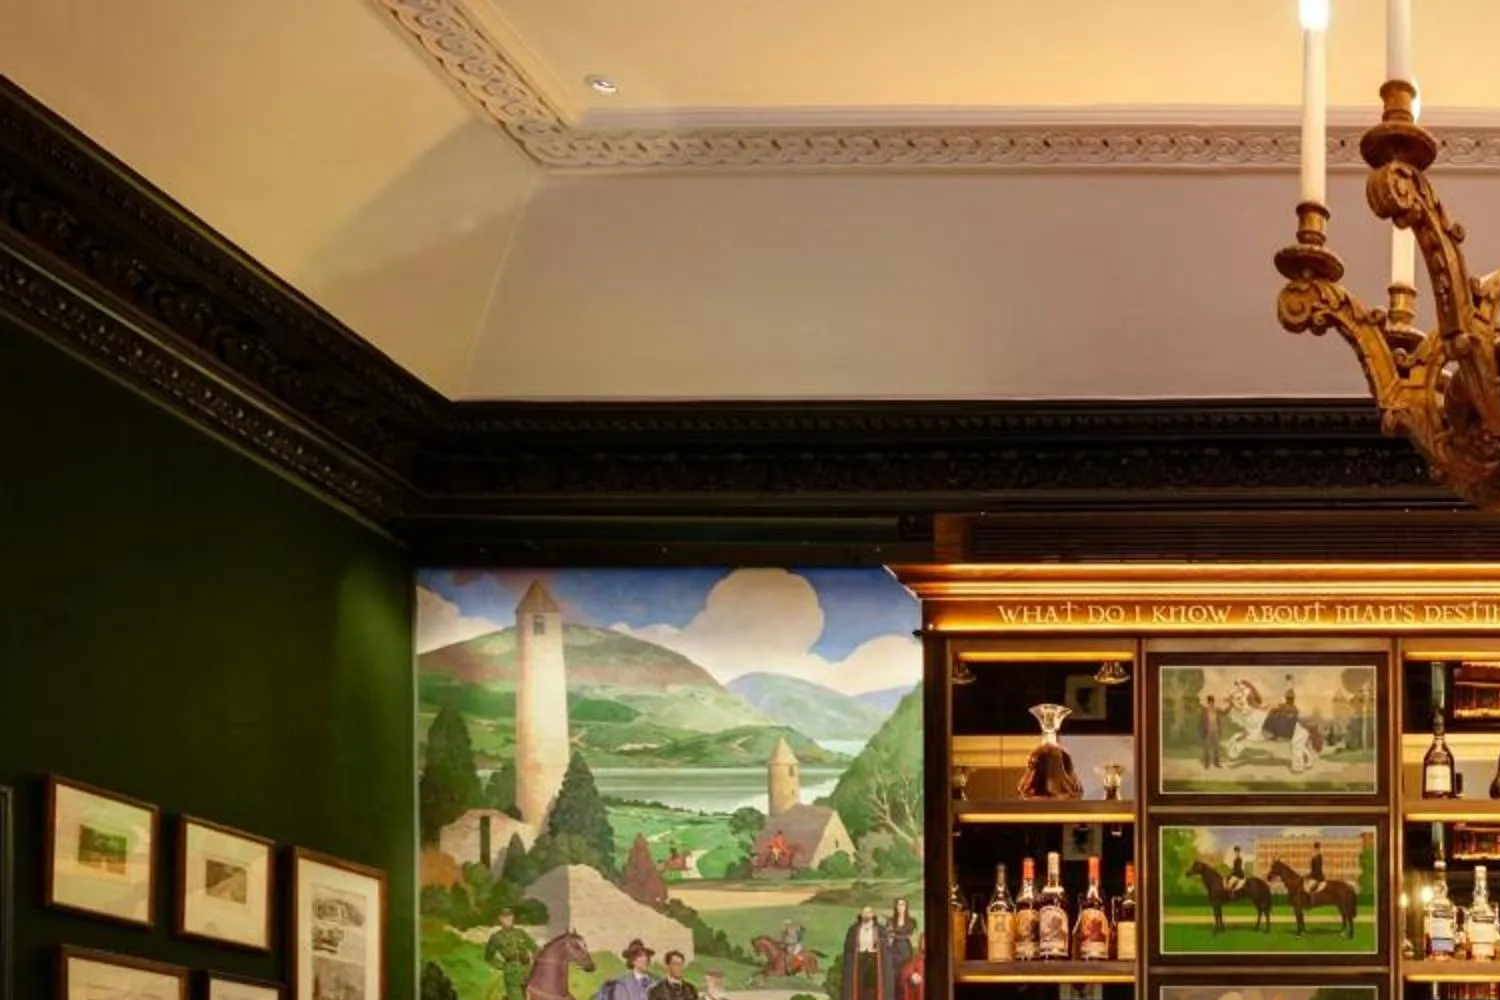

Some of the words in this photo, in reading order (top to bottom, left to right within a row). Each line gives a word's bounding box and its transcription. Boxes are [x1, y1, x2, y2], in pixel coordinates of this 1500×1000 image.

[997, 601, 1080, 624] WHAT
[1087, 604, 1125, 624] DO
[1134, 605, 1141, 623] I
[1152, 604, 1233, 624] KNOW
[1245, 601, 1328, 623] ABOUT
[1334, 604, 1416, 623] MAN'S
